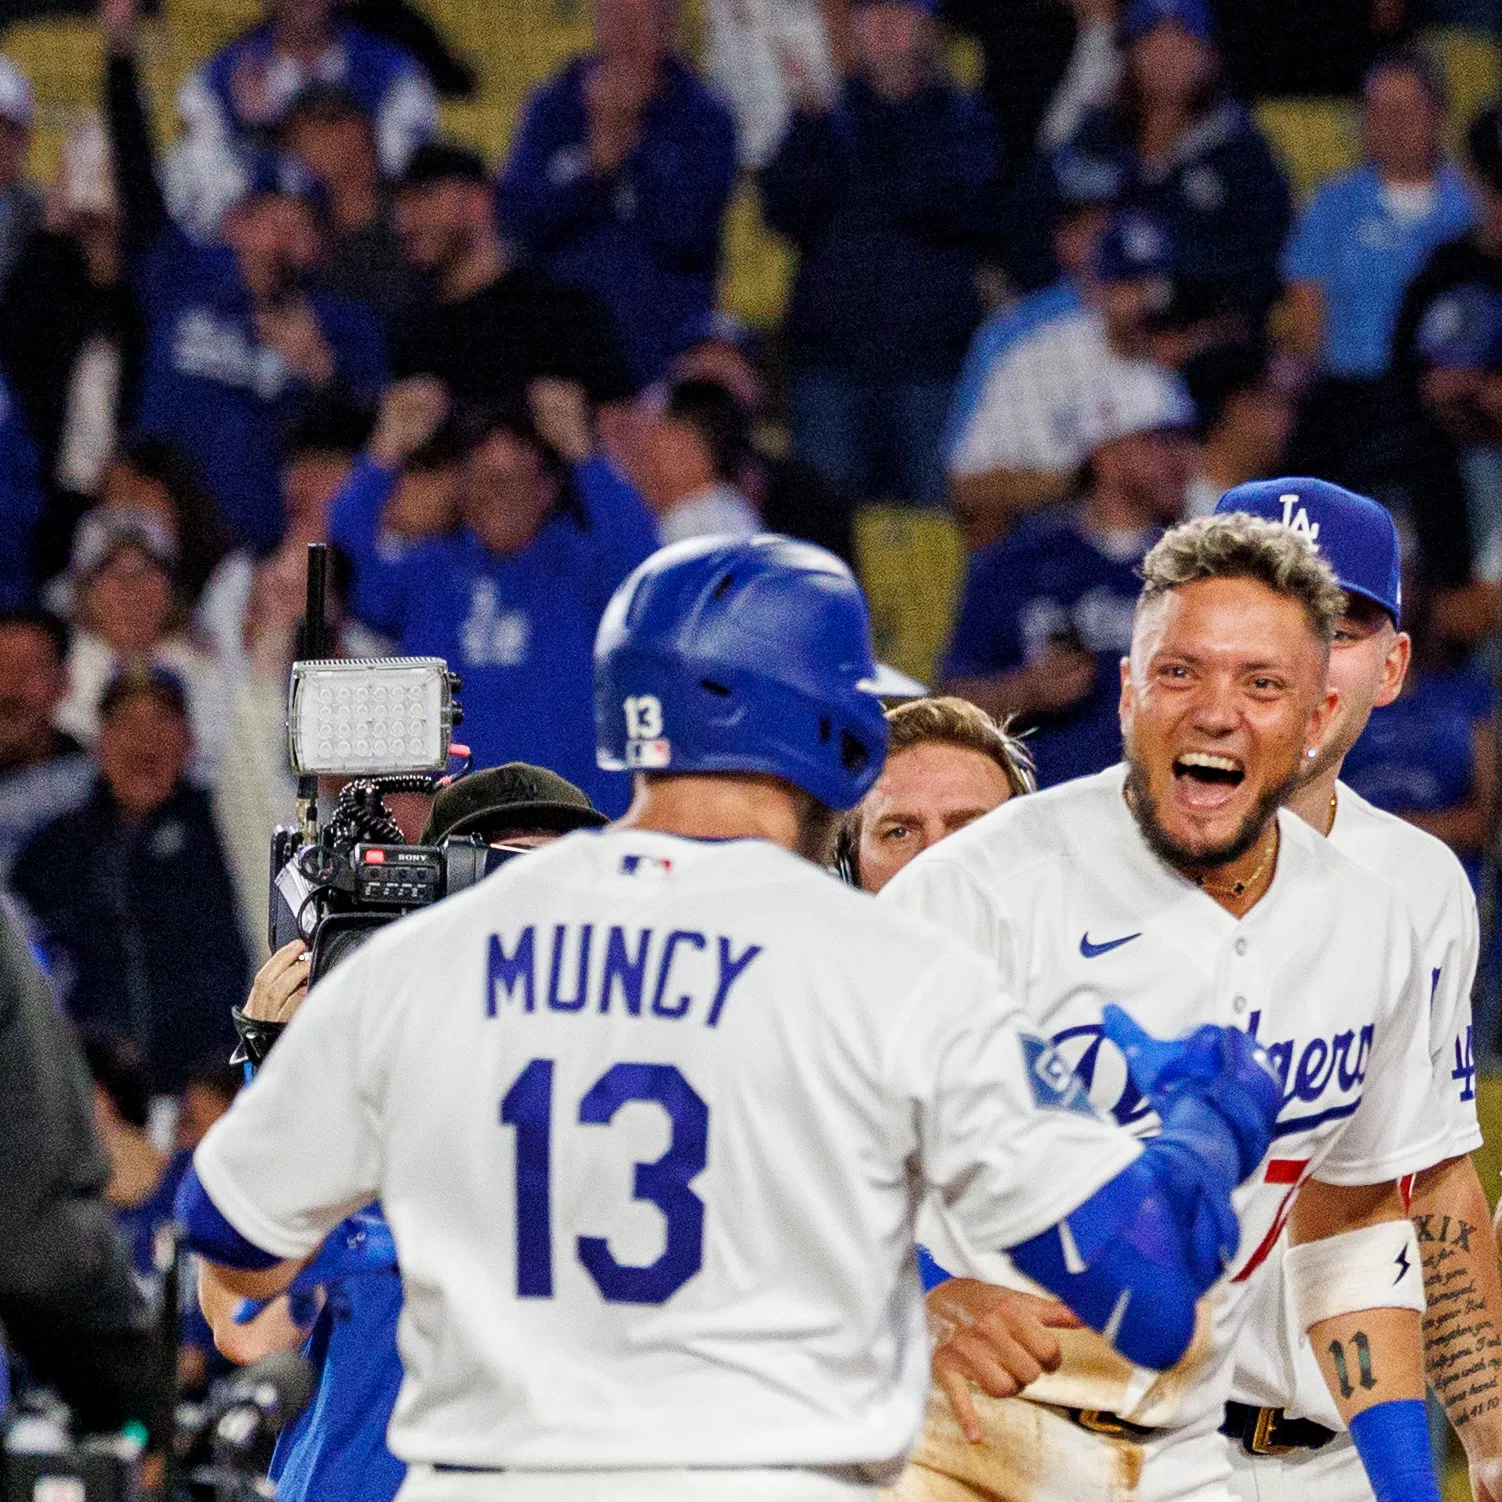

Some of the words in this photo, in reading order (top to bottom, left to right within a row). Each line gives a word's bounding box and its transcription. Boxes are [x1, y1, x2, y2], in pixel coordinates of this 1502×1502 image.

[623, 696, 662, 741] 13
[398, 853, 427, 862] SONY
[485, 923, 764, 1029] MUNCY
[498, 1058, 709, 1306] 13
